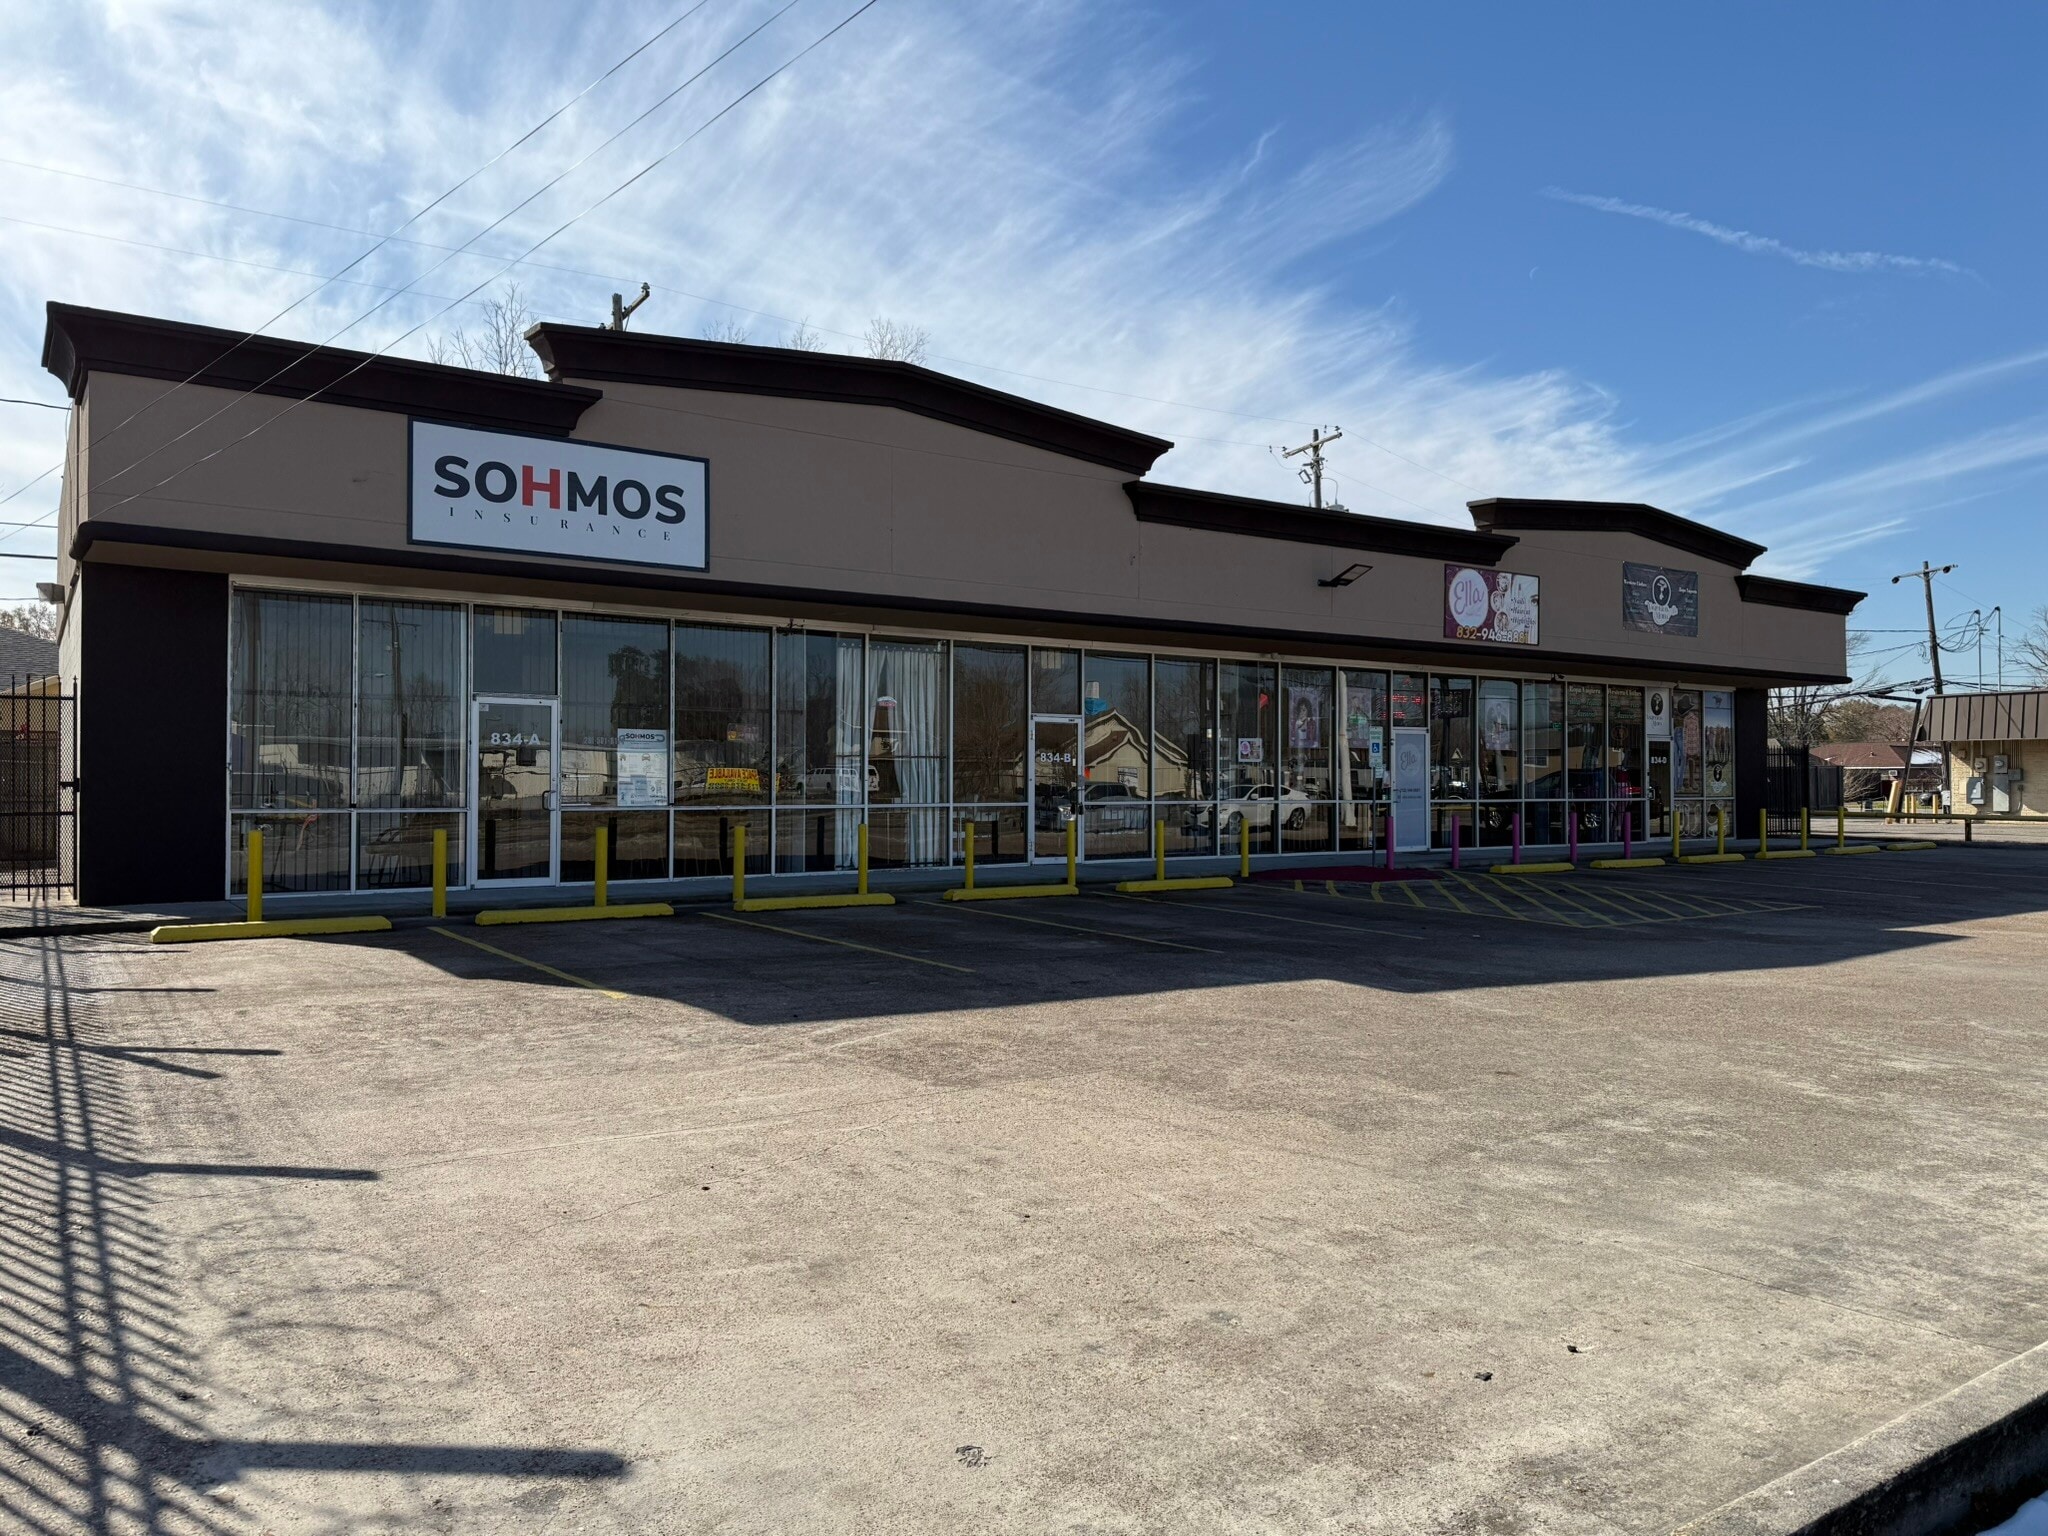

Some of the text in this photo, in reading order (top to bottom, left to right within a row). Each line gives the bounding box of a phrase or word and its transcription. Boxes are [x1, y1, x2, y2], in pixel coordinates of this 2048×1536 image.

[434, 455, 686, 524] SOHMOS
[449, 507, 671, 541] INSURANCE
[1454, 580, 1485, 615] Ella
[490, 732, 541, 745] 834-A
[1040, 752, 1071, 763] 834-B
[1400, 750, 1418, 771] Ella
